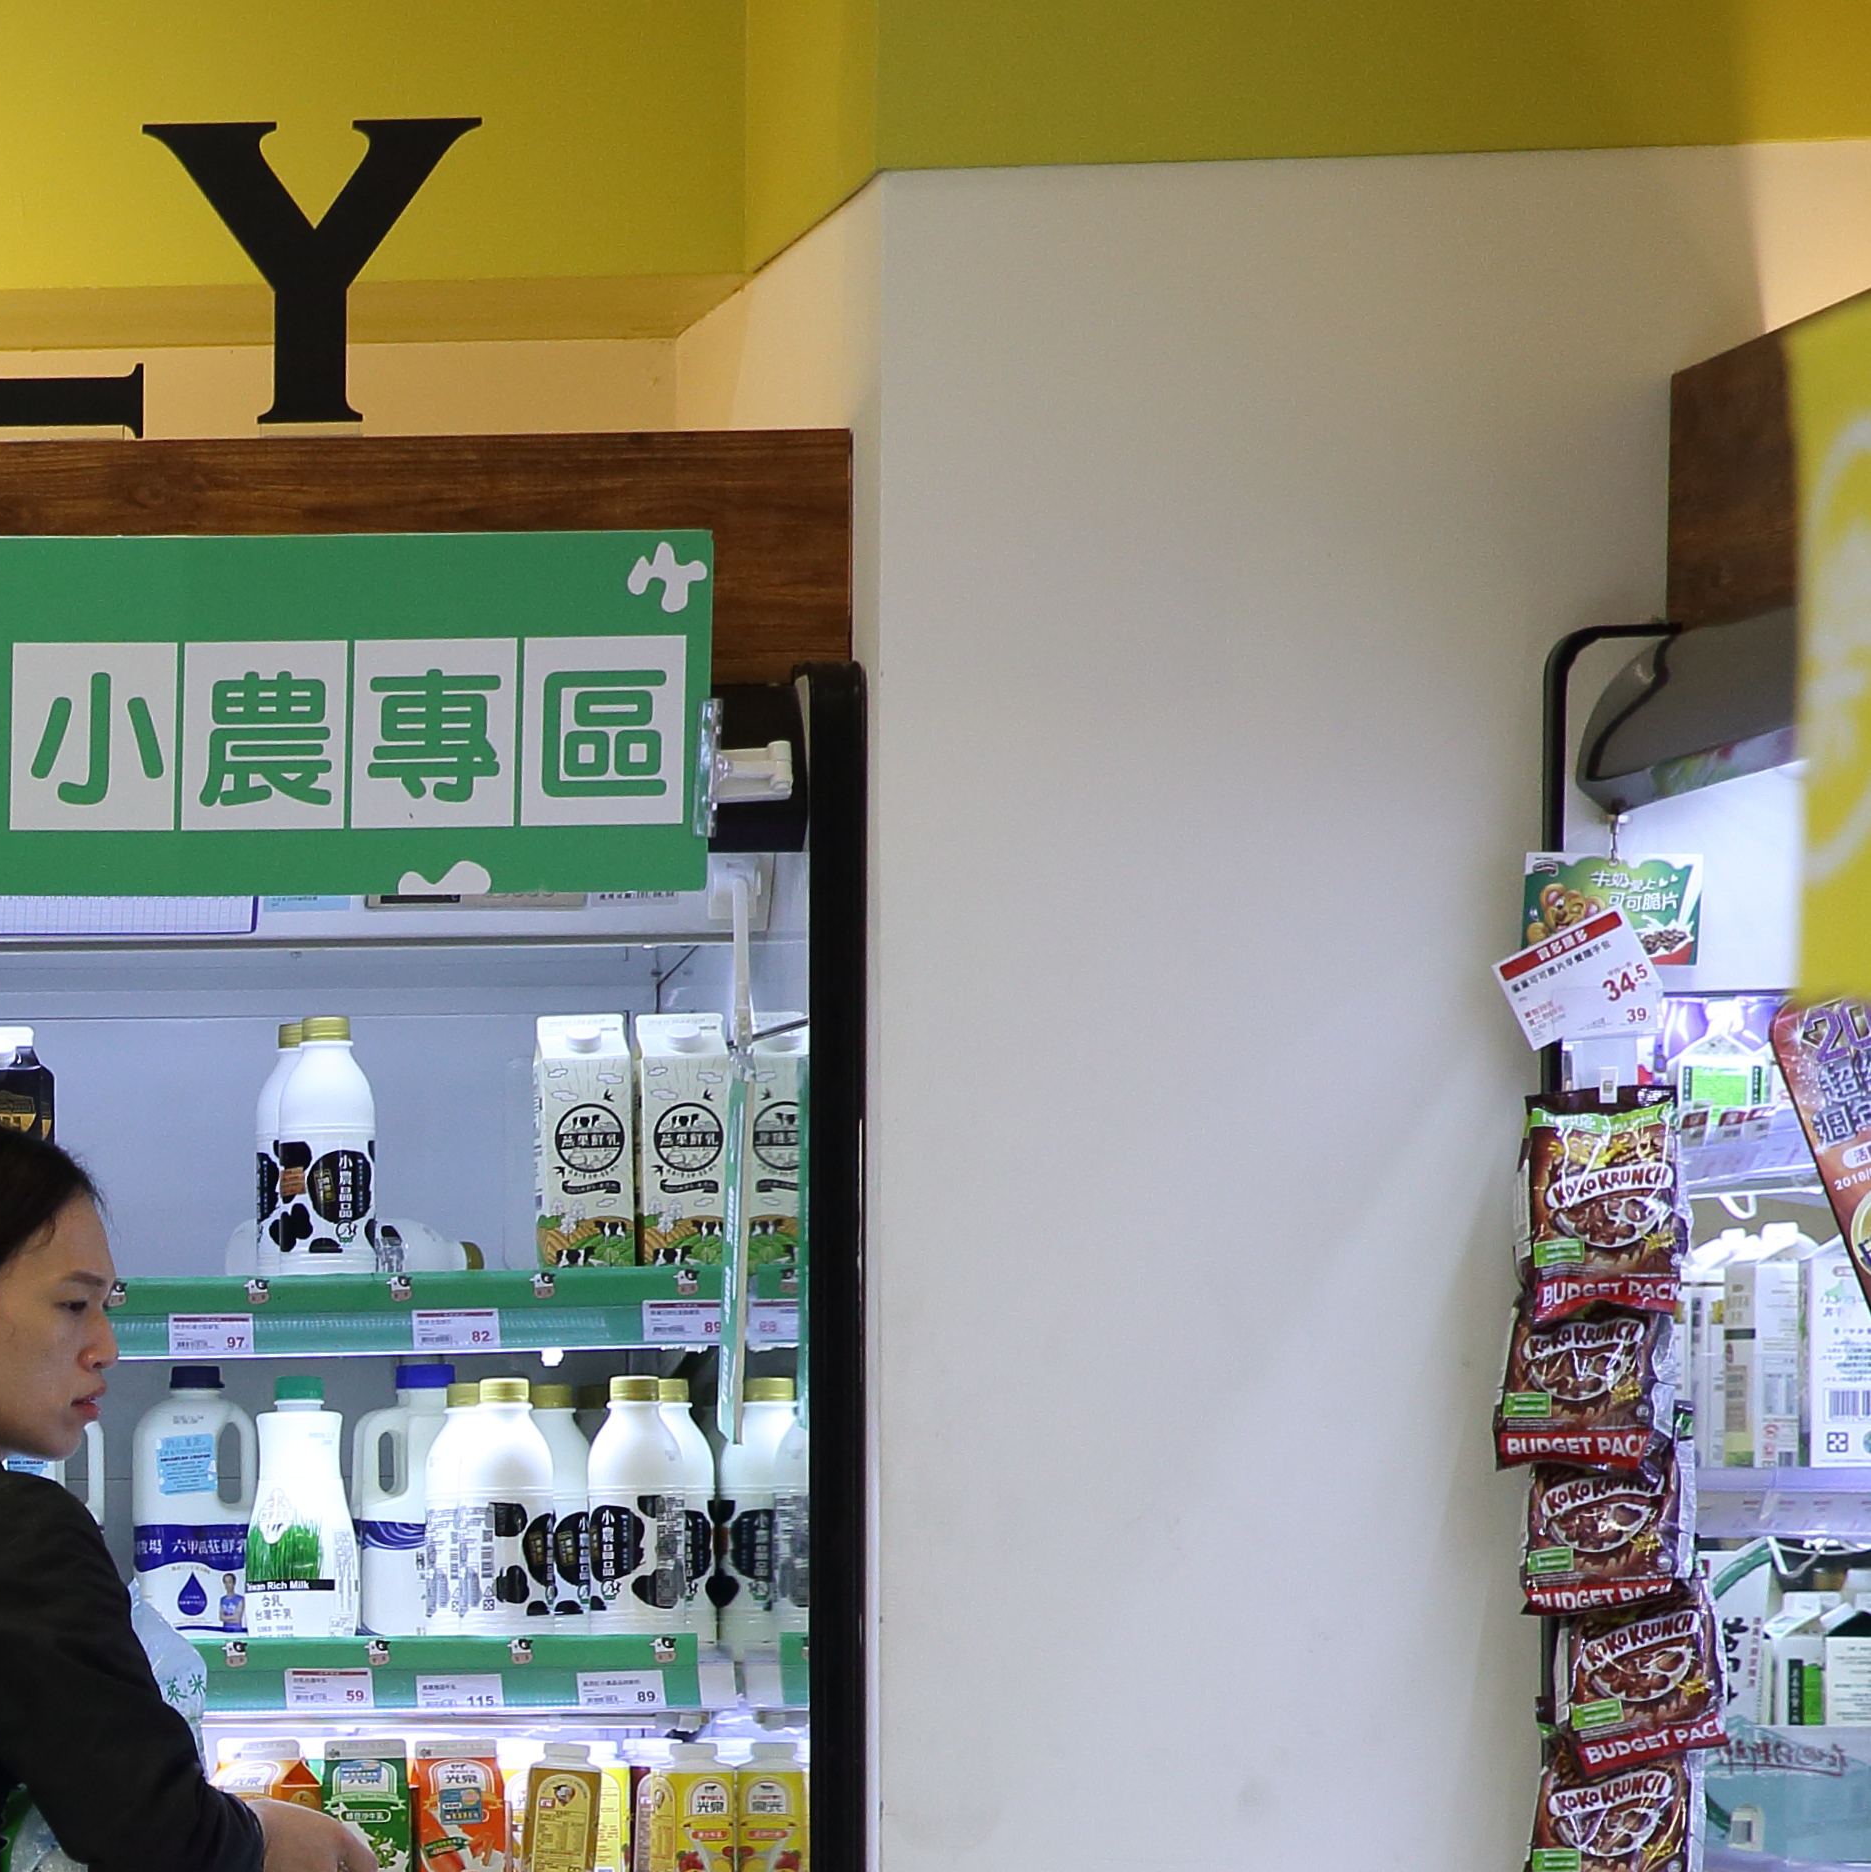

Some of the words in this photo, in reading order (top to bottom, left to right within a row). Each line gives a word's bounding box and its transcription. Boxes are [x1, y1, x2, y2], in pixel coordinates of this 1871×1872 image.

[30, 668, 669, 807] 小農專區
[1602, 963, 1648, 1001] 34.5
[1626, 1008, 1647, 1022] 39
[1541, 1281, 1623, 1307] BUDGET
[1628, 1279, 1679, 1300] PACK
[226, 1334, 247, 1351] 97
[472, 1330, 491, 1342] 82
[1529, 1326, 1572, 1355] KOKO
[1574, 1320, 1640, 1344] KRUNCH
[1506, 1437, 1592, 1455] BUDGET
[267, 1582, 287, 1591] Rich
[290, 1581, 309, 1590] Milk
[1585, 1635, 1628, 1667] KOKO
[1630, 1613, 1694, 1644] KRUNCH
[346, 1689, 365, 1704] 59
[467, 1694, 494, 1707] 115
[637, 1690, 656, 1704] 89
[1555, 1790, 1600, 1813] KOKO
[1602, 1771, 1669, 1802] KRUNCH
